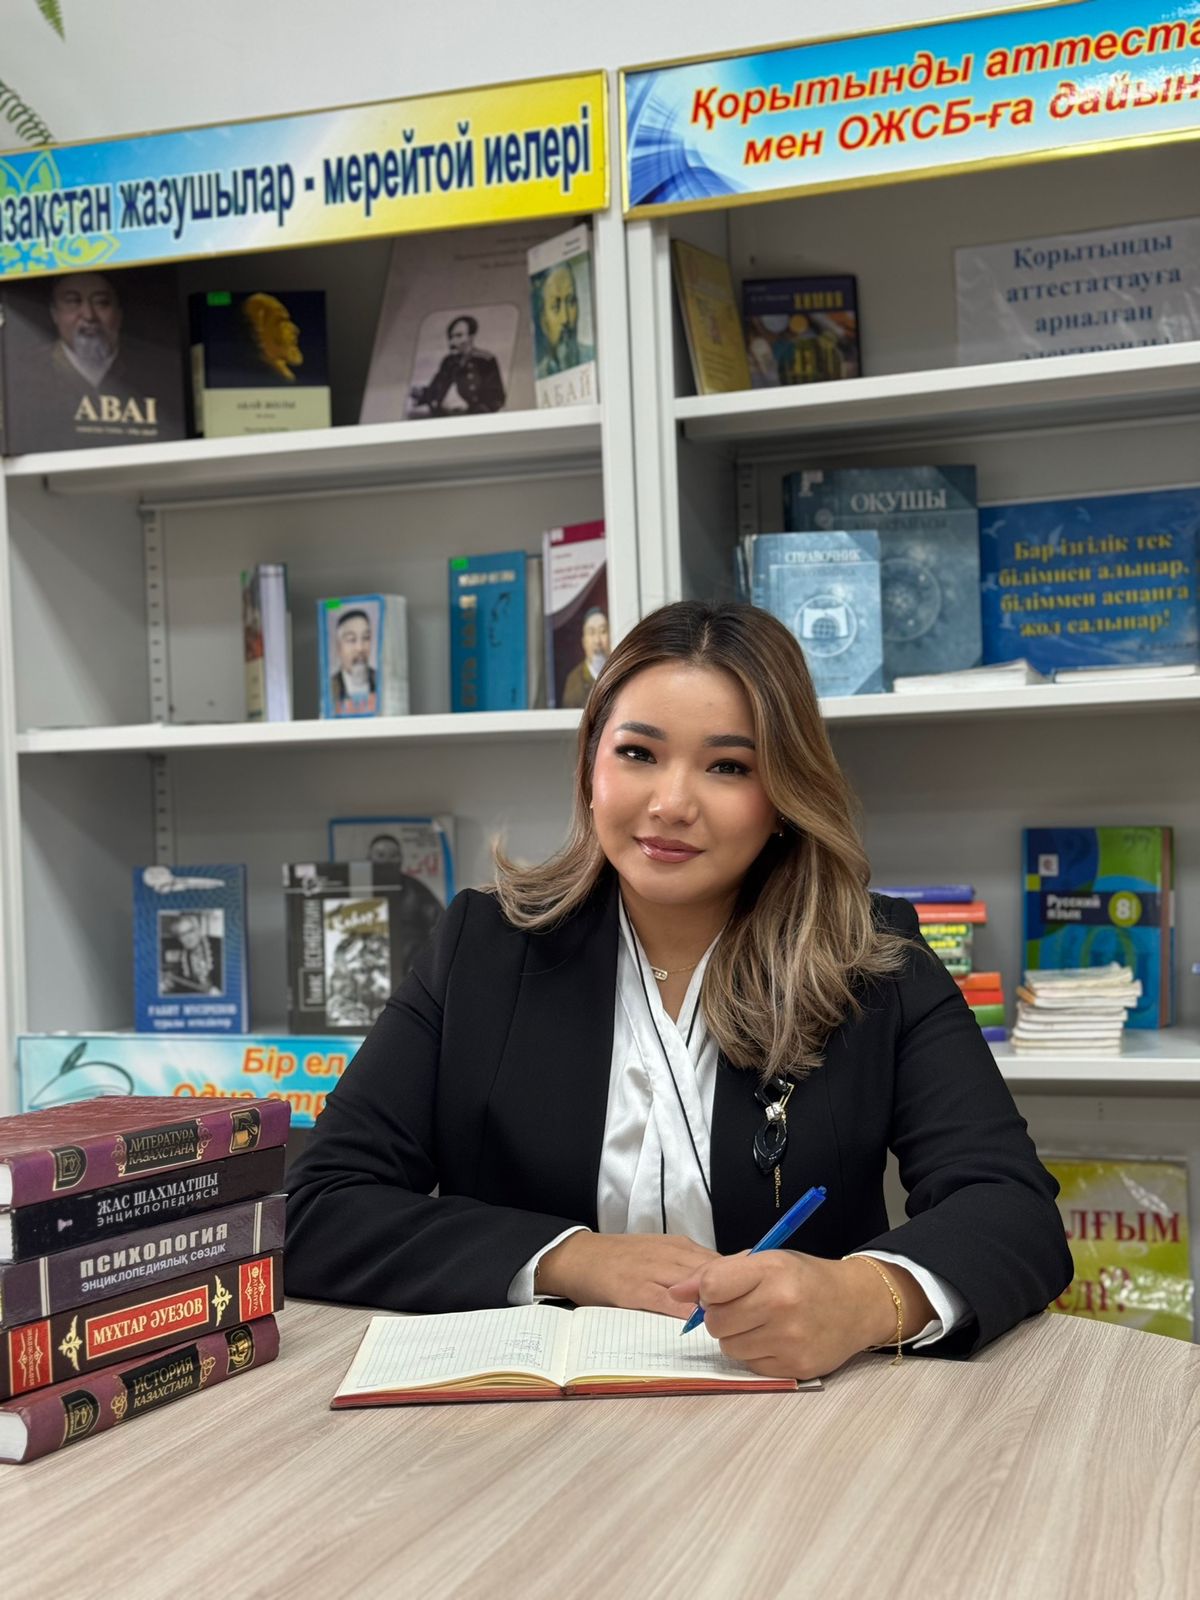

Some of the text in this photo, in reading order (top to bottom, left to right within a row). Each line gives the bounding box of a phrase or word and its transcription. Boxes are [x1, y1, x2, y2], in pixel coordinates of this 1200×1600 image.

[691, 52, 972, 130] Қорытынды
[744, 129, 823, 165] мен
[838, 98, 1033, 150] ОЖСБ-ға
[0, 186, 112, 248] зақстан
[119, 163, 295, 239] жазушылар
[324, 121, 474, 217] мерейтой
[485, 105, 590, 193] иелері
[1136, 533, 1173, 549] тек
[1116, 898, 1131, 920] 8
[242, 1048, 296, 1080] Бір
[129, 1128, 195, 1153] ЛИТЕРАТУРА
[97, 1172, 218, 1216] ЖАС ШАХМАТШЫ
[97, 1187, 219, 1227] ЭНЦИКЛОПЕДИЯСЫ
[80, 1223, 228, 1279] ПСИХОЛОГИЯ
[81, 1243, 226, 1292] ЭНЦИКЛОПЕДИЯЛЫҚ СӨЗДІК
[93, 1297, 203, 1346] МҰХТАР ӘУЕЗОВ
[133, 1356, 194, 1395] ИСТОРИЯ
[133, 1375, 194, 1409] КАЗАХСТАНА
